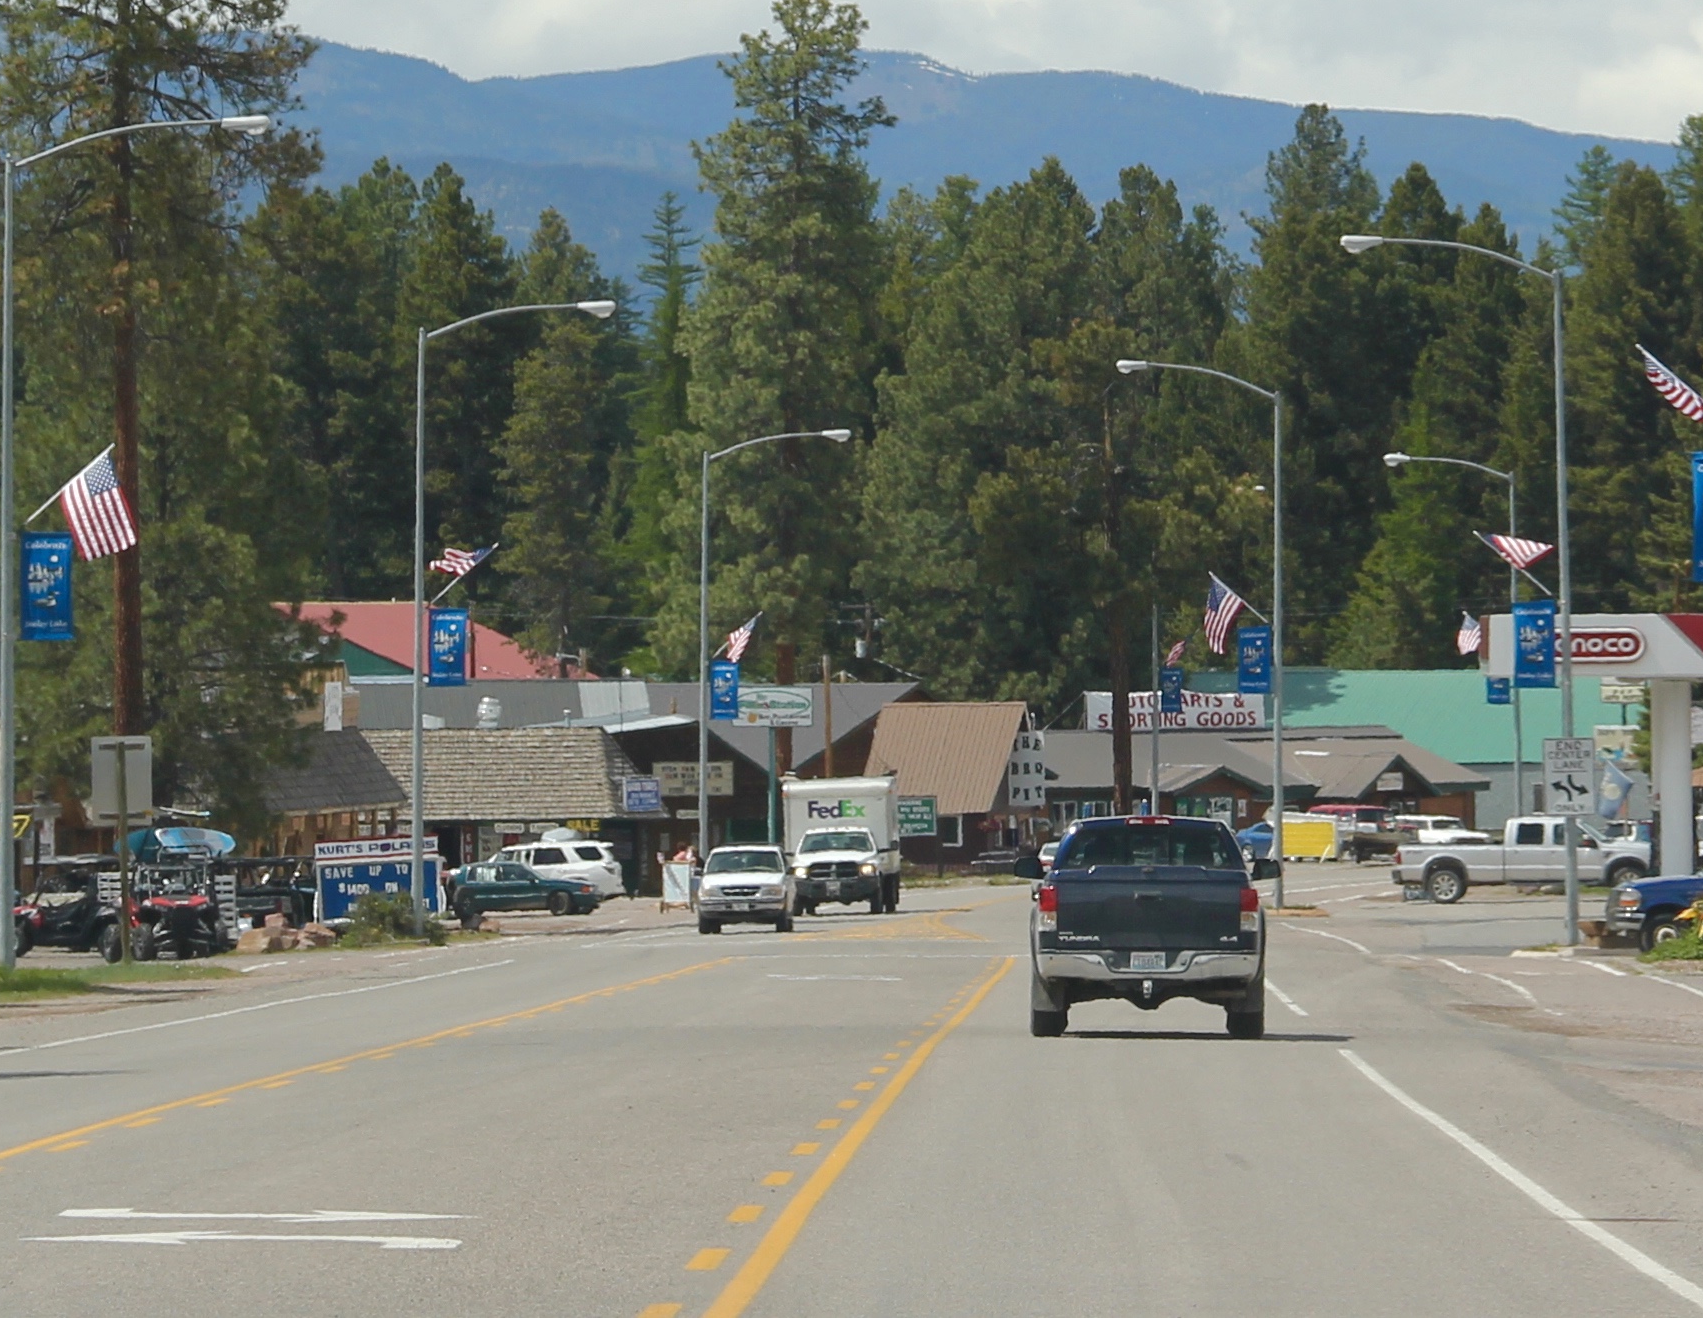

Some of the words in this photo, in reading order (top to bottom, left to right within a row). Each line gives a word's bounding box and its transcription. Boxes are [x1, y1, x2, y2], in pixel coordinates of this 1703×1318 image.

[1196, 710, 1257, 726] GOODS
[1012, 786, 1043, 801] PIT
[807, 799, 866, 819] FedEx
[318, 844, 363, 855] KURT'S
[325, 866, 354, 880] SAVE
[368, 865, 382, 877] UP
[395, 863, 409, 875] TO
